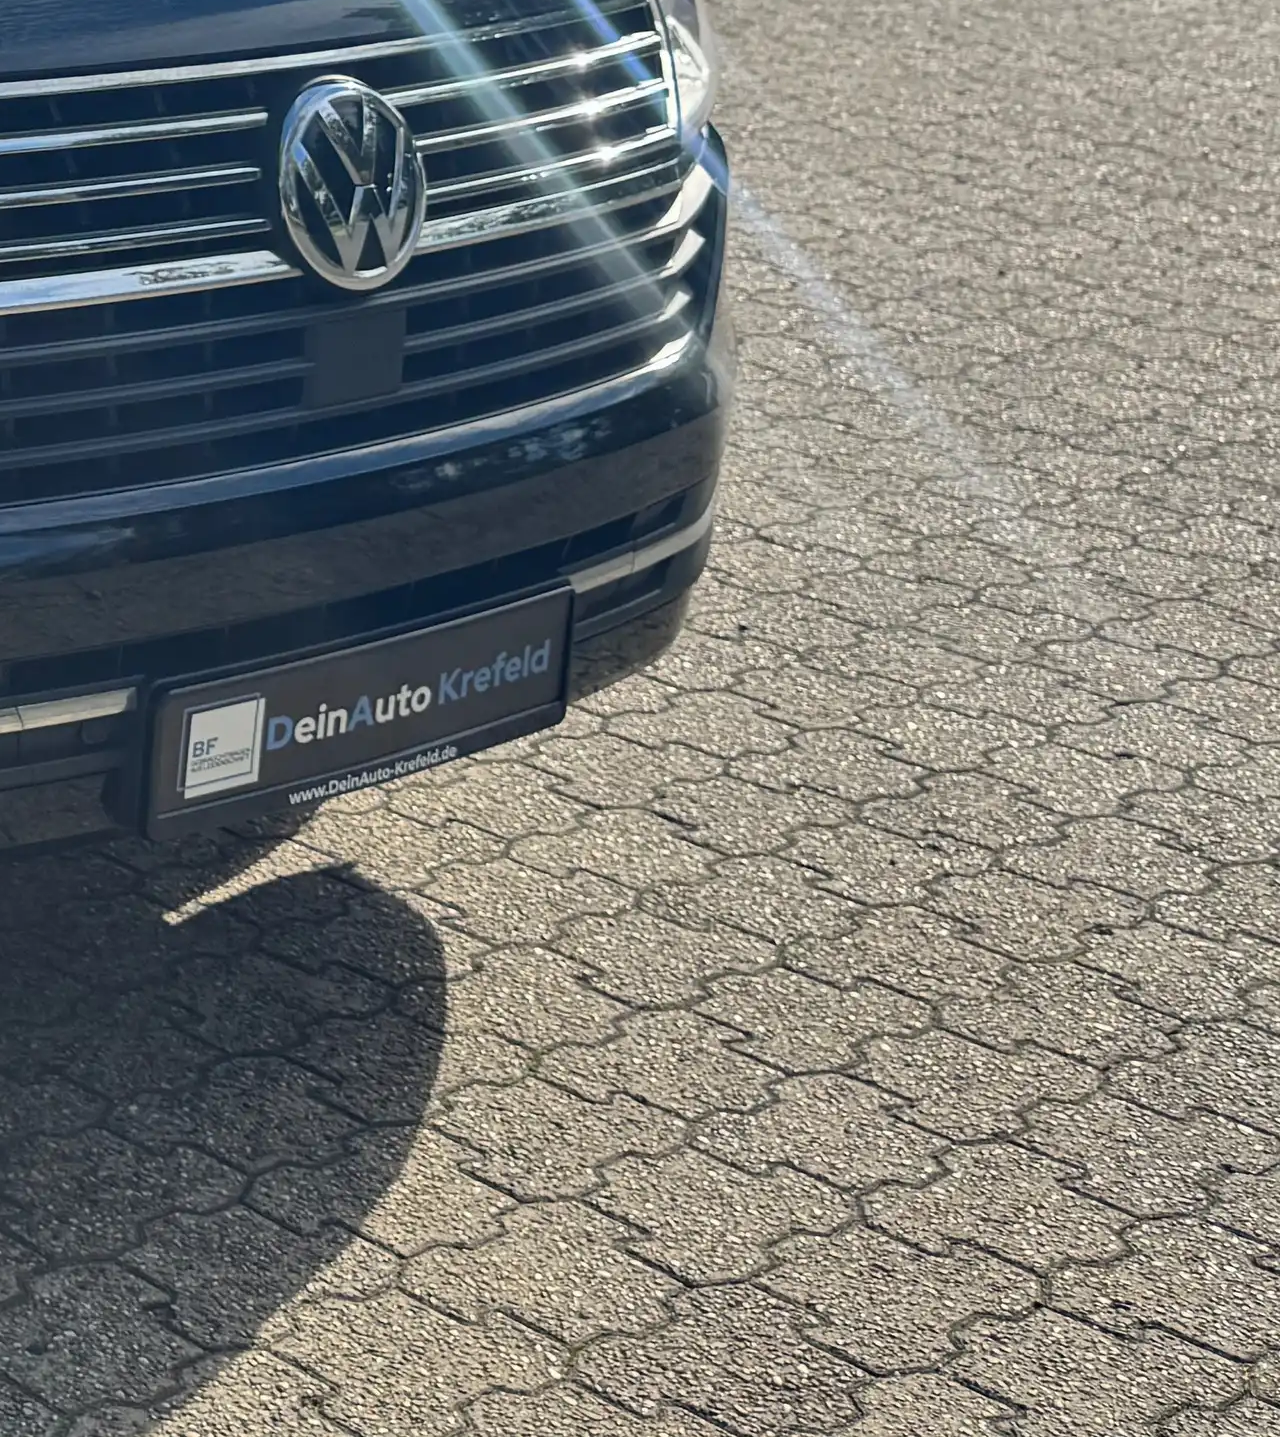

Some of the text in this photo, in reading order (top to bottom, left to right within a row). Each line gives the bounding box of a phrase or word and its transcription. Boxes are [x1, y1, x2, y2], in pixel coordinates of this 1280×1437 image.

[266, 638, 552, 752] DeinAuto Krefeld
[192, 736, 219, 758] BF
[289, 744, 459, 806] www.DeinAuto-Krefeld.de
